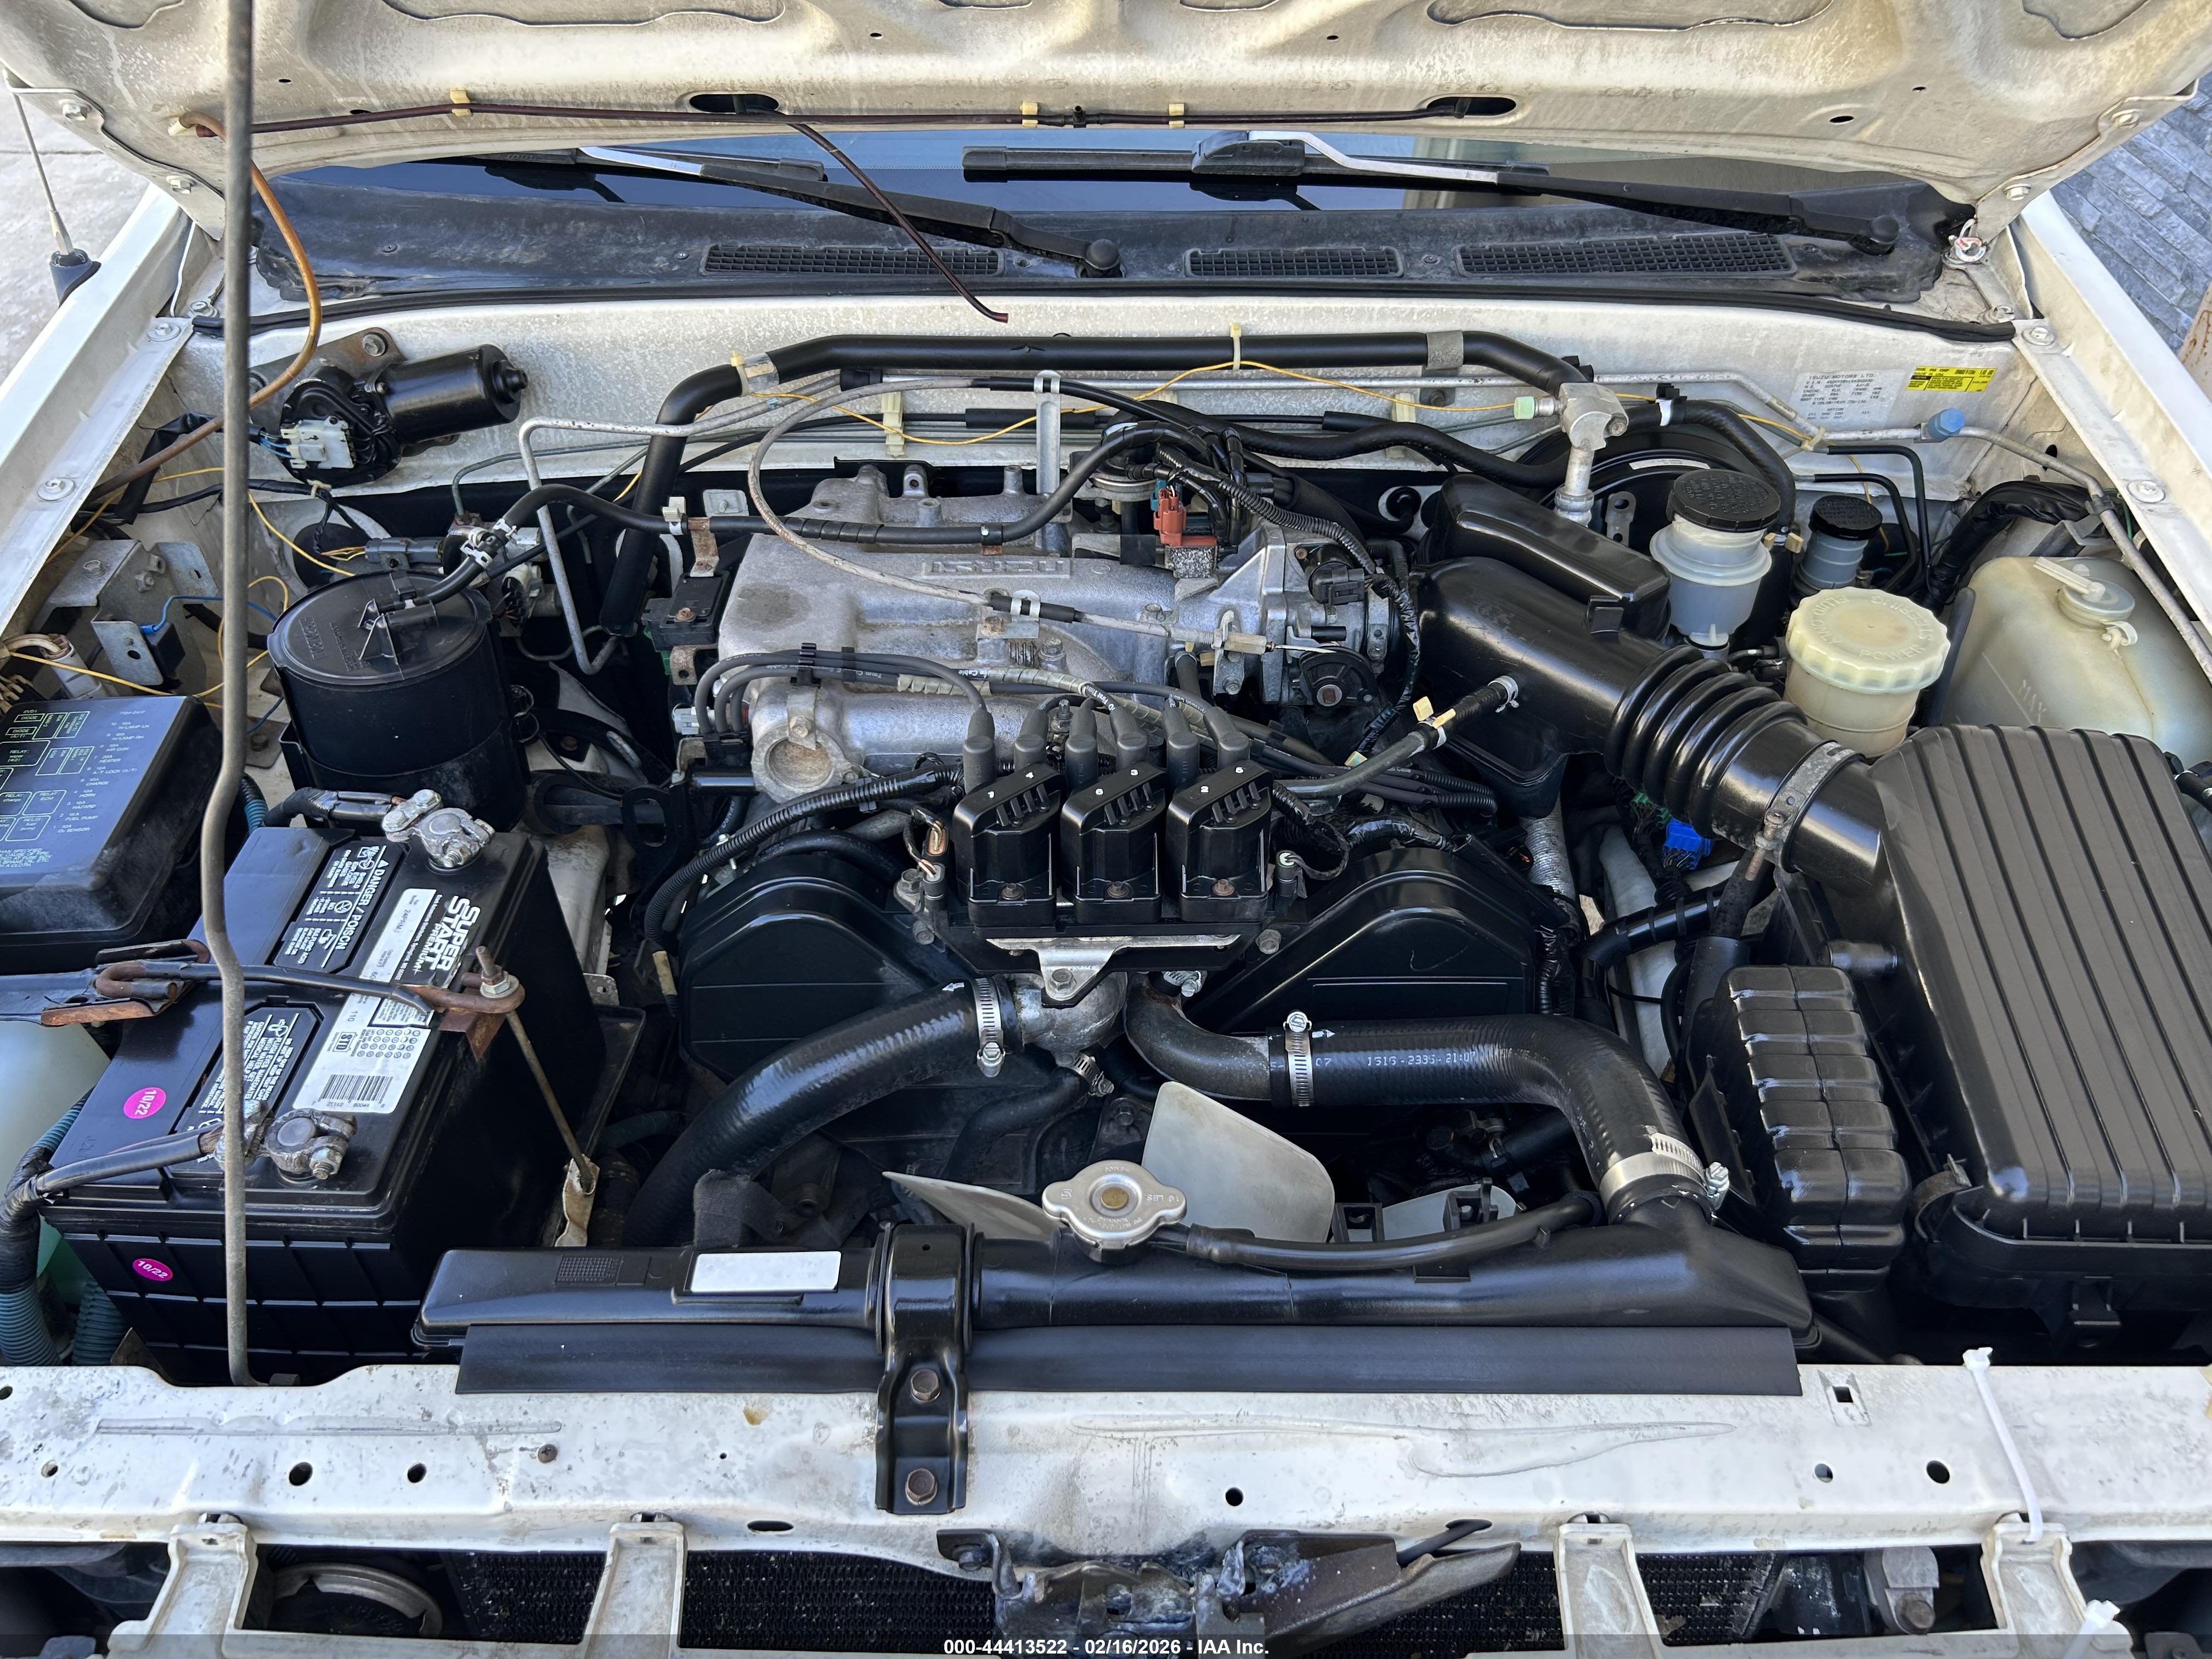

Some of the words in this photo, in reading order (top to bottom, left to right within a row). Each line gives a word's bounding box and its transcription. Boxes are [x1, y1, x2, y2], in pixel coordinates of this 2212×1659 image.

[932, 560, 1064, 573] ISUZU
[1812, 594, 1849, 616] FLUID
[1869, 596, 1932, 641] STEERING
[1810, 619, 1843, 645] ONLY
[1858, 644, 1926, 661] POWER
[338, 861, 353, 877] GASES
[340, 861, 360, 886] EXPLOSIVE
[347, 871, 360, 884] EYES
[352, 871, 368, 889] SHIELD
[357, 868, 386, 905] DANGER
[326, 902, 337, 910] NO
[306, 927, 315, 936] CAN
[334, 914, 362, 949] POISON
[425, 895, 470, 970] START
[437, 905, 481, 971] SUPER
[298, 936, 311, 950] CAUSE
[303, 928, 322, 951] SULFURIC
[296, 952, 309, 964] ACID
[346, 1010, 359, 1022] 110
[250, 1037, 268, 1059] MEDICAL
[262, 1037, 275, 1050] WITH
[268, 1037, 283, 1053] FLUSH
[278, 1045, 289, 1055] NOT
[336, 1034, 353, 1051] STD
[283, 1047, 294, 1058] KEEP
[260, 1054, 273, 1068] EYES
[278, 1058, 288, 1067] OUT
[245, 1071, 257, 1082] GET
[267, 1064, 279, 1076] KEEP
[261, 1076, 273, 1088] VENT
[268, 1076, 279, 1085] THE
[261, 1085, 274, 1100] REACH
[134, 1090, 157, 1116] 10/22
[1144, 1193, 1164, 1202] LBS.
[138, 1260, 168, 1279] 10/22
